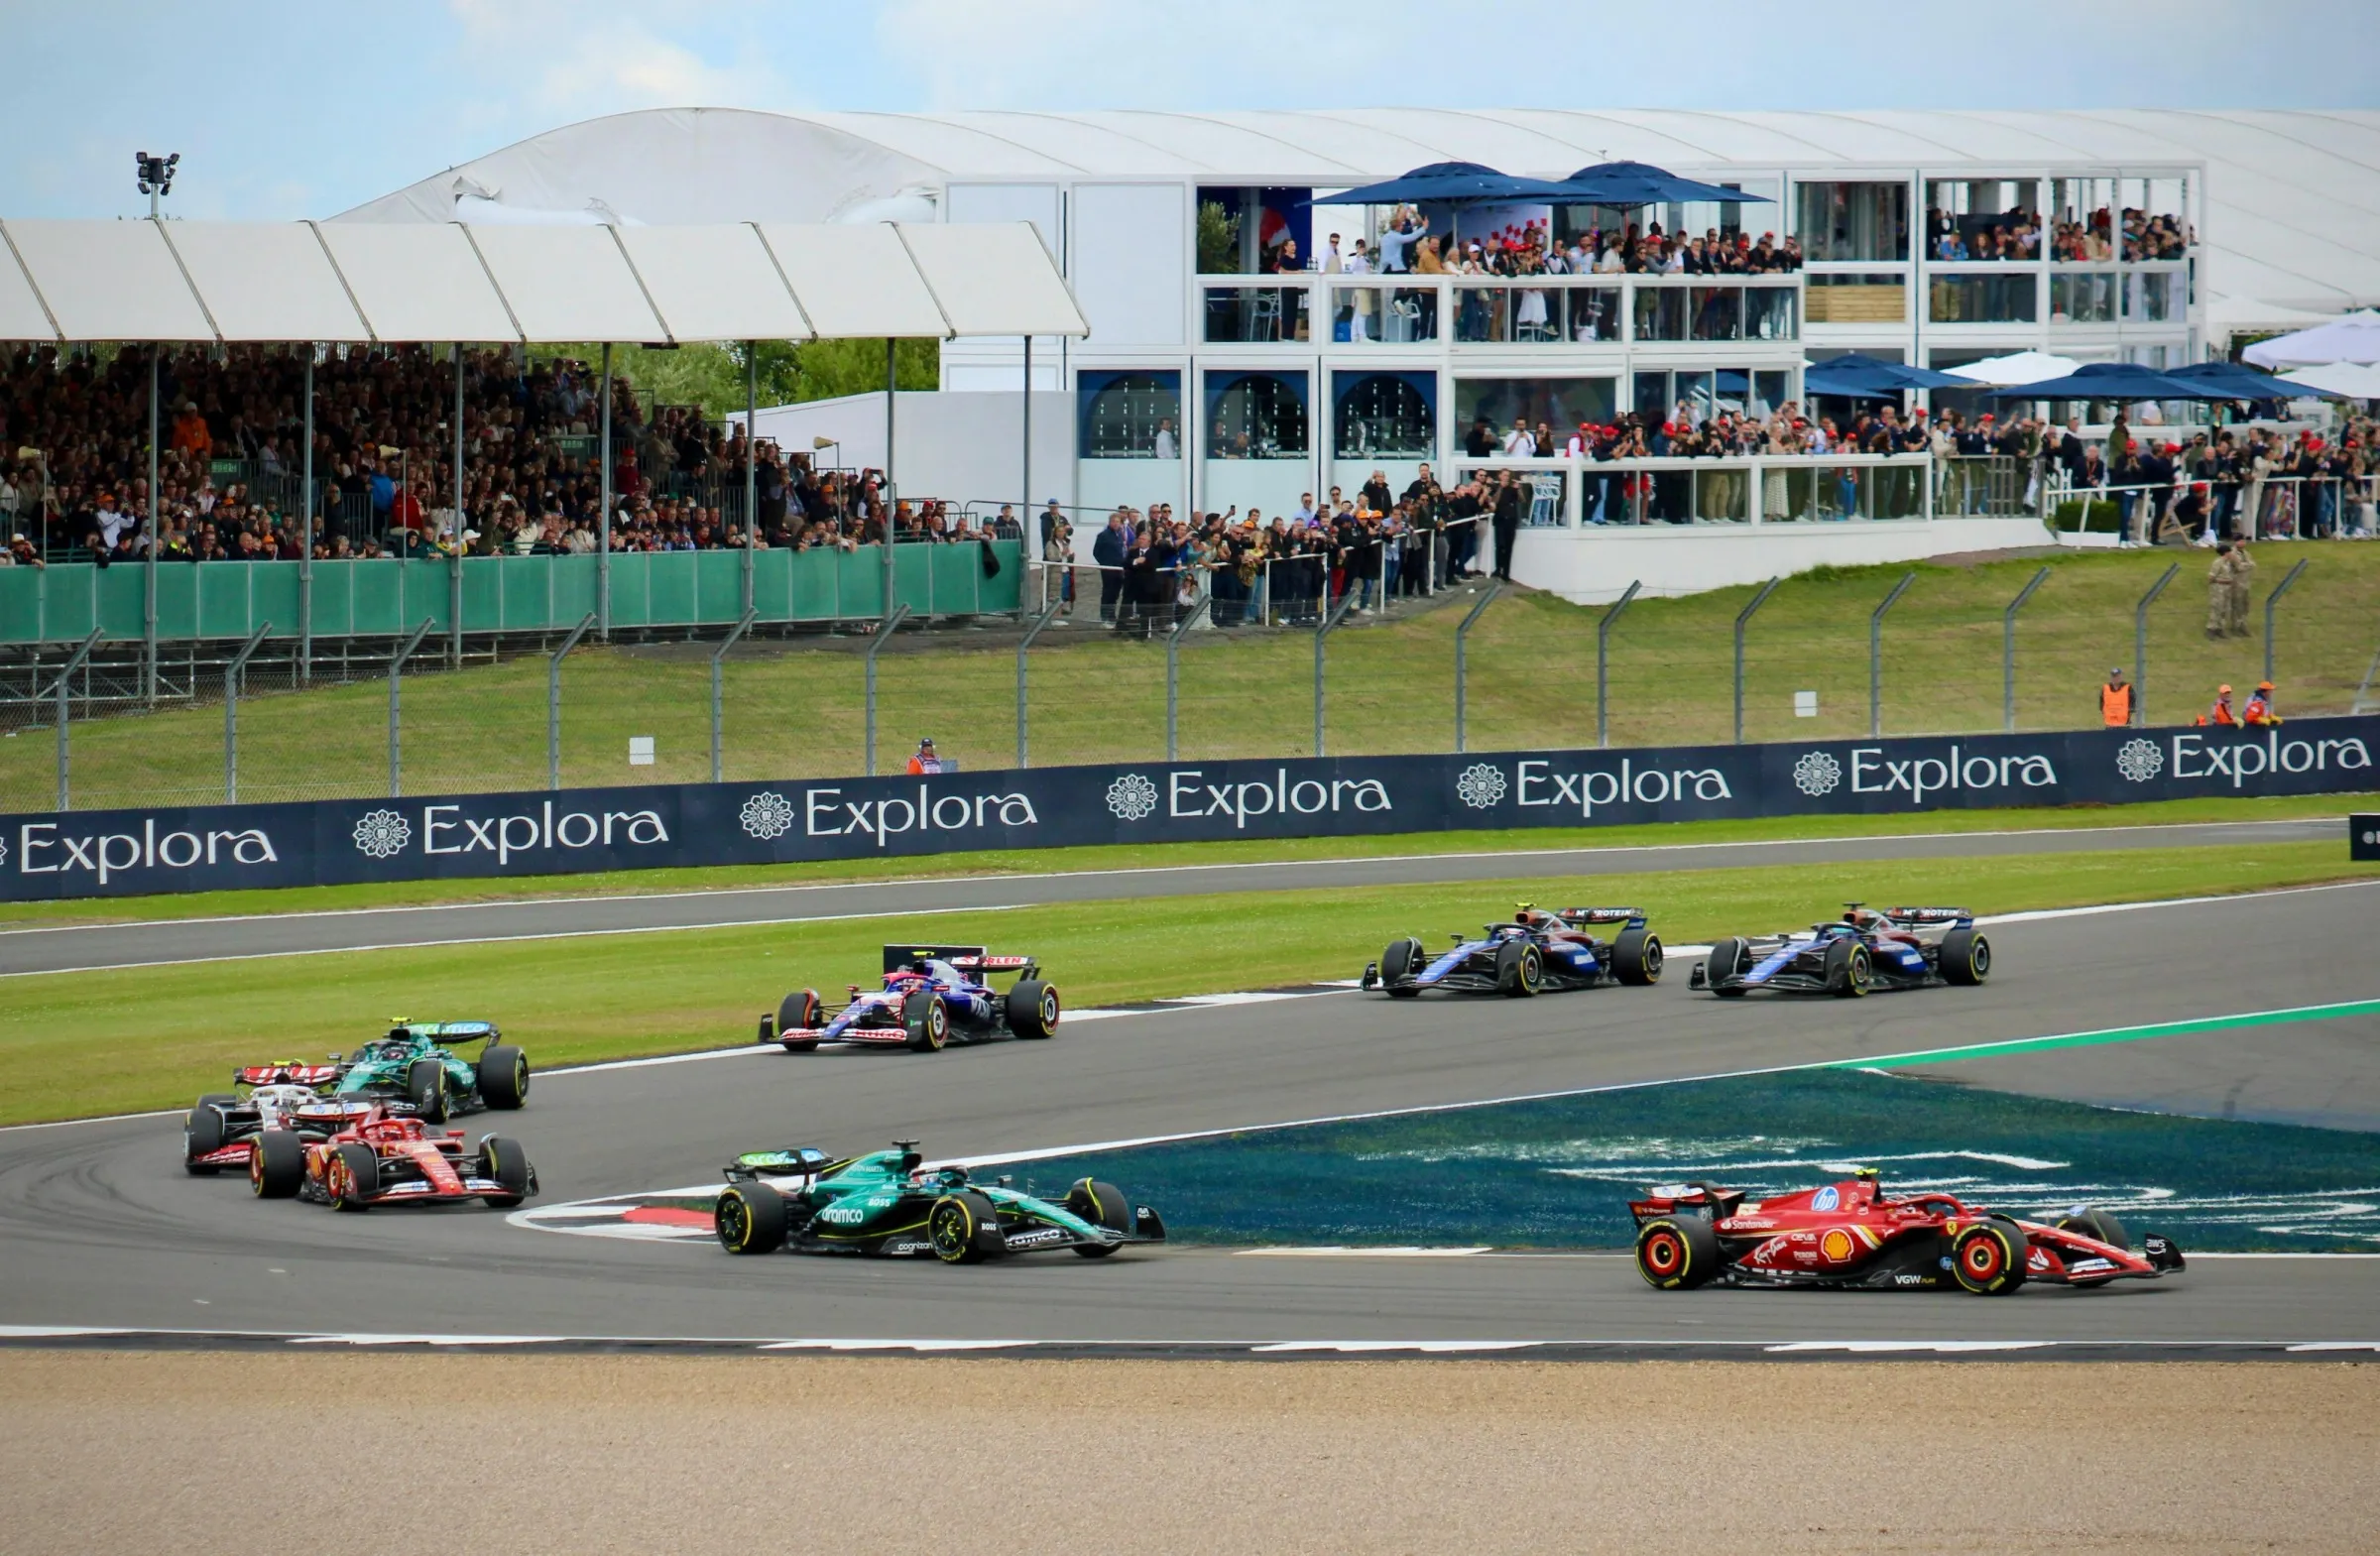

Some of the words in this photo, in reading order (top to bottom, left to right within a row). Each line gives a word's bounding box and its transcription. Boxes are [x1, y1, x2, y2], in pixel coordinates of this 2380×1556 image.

[1851, 745, 2057, 804] Explora
[2173, 730, 2371, 788] Explora
[1169, 768, 1392, 829] Explora
[1517, 758, 1732, 818] Explora
[424, 800, 669, 866] Explora
[806, 783, 1038, 847] Explora
[21, 818, 278, 885] Explora
[821, 1208, 864, 1224] aramco
[1813, 1188, 1839, 1211] hp
[981, 1222, 998, 1231] BOSS
[1731, 1220, 1774, 1229] Santander
[2146, 1239, 2167, 1249] aws
[897, 1241, 933, 1252] cognizan
[1895, 1274, 1921, 1284] VGW
